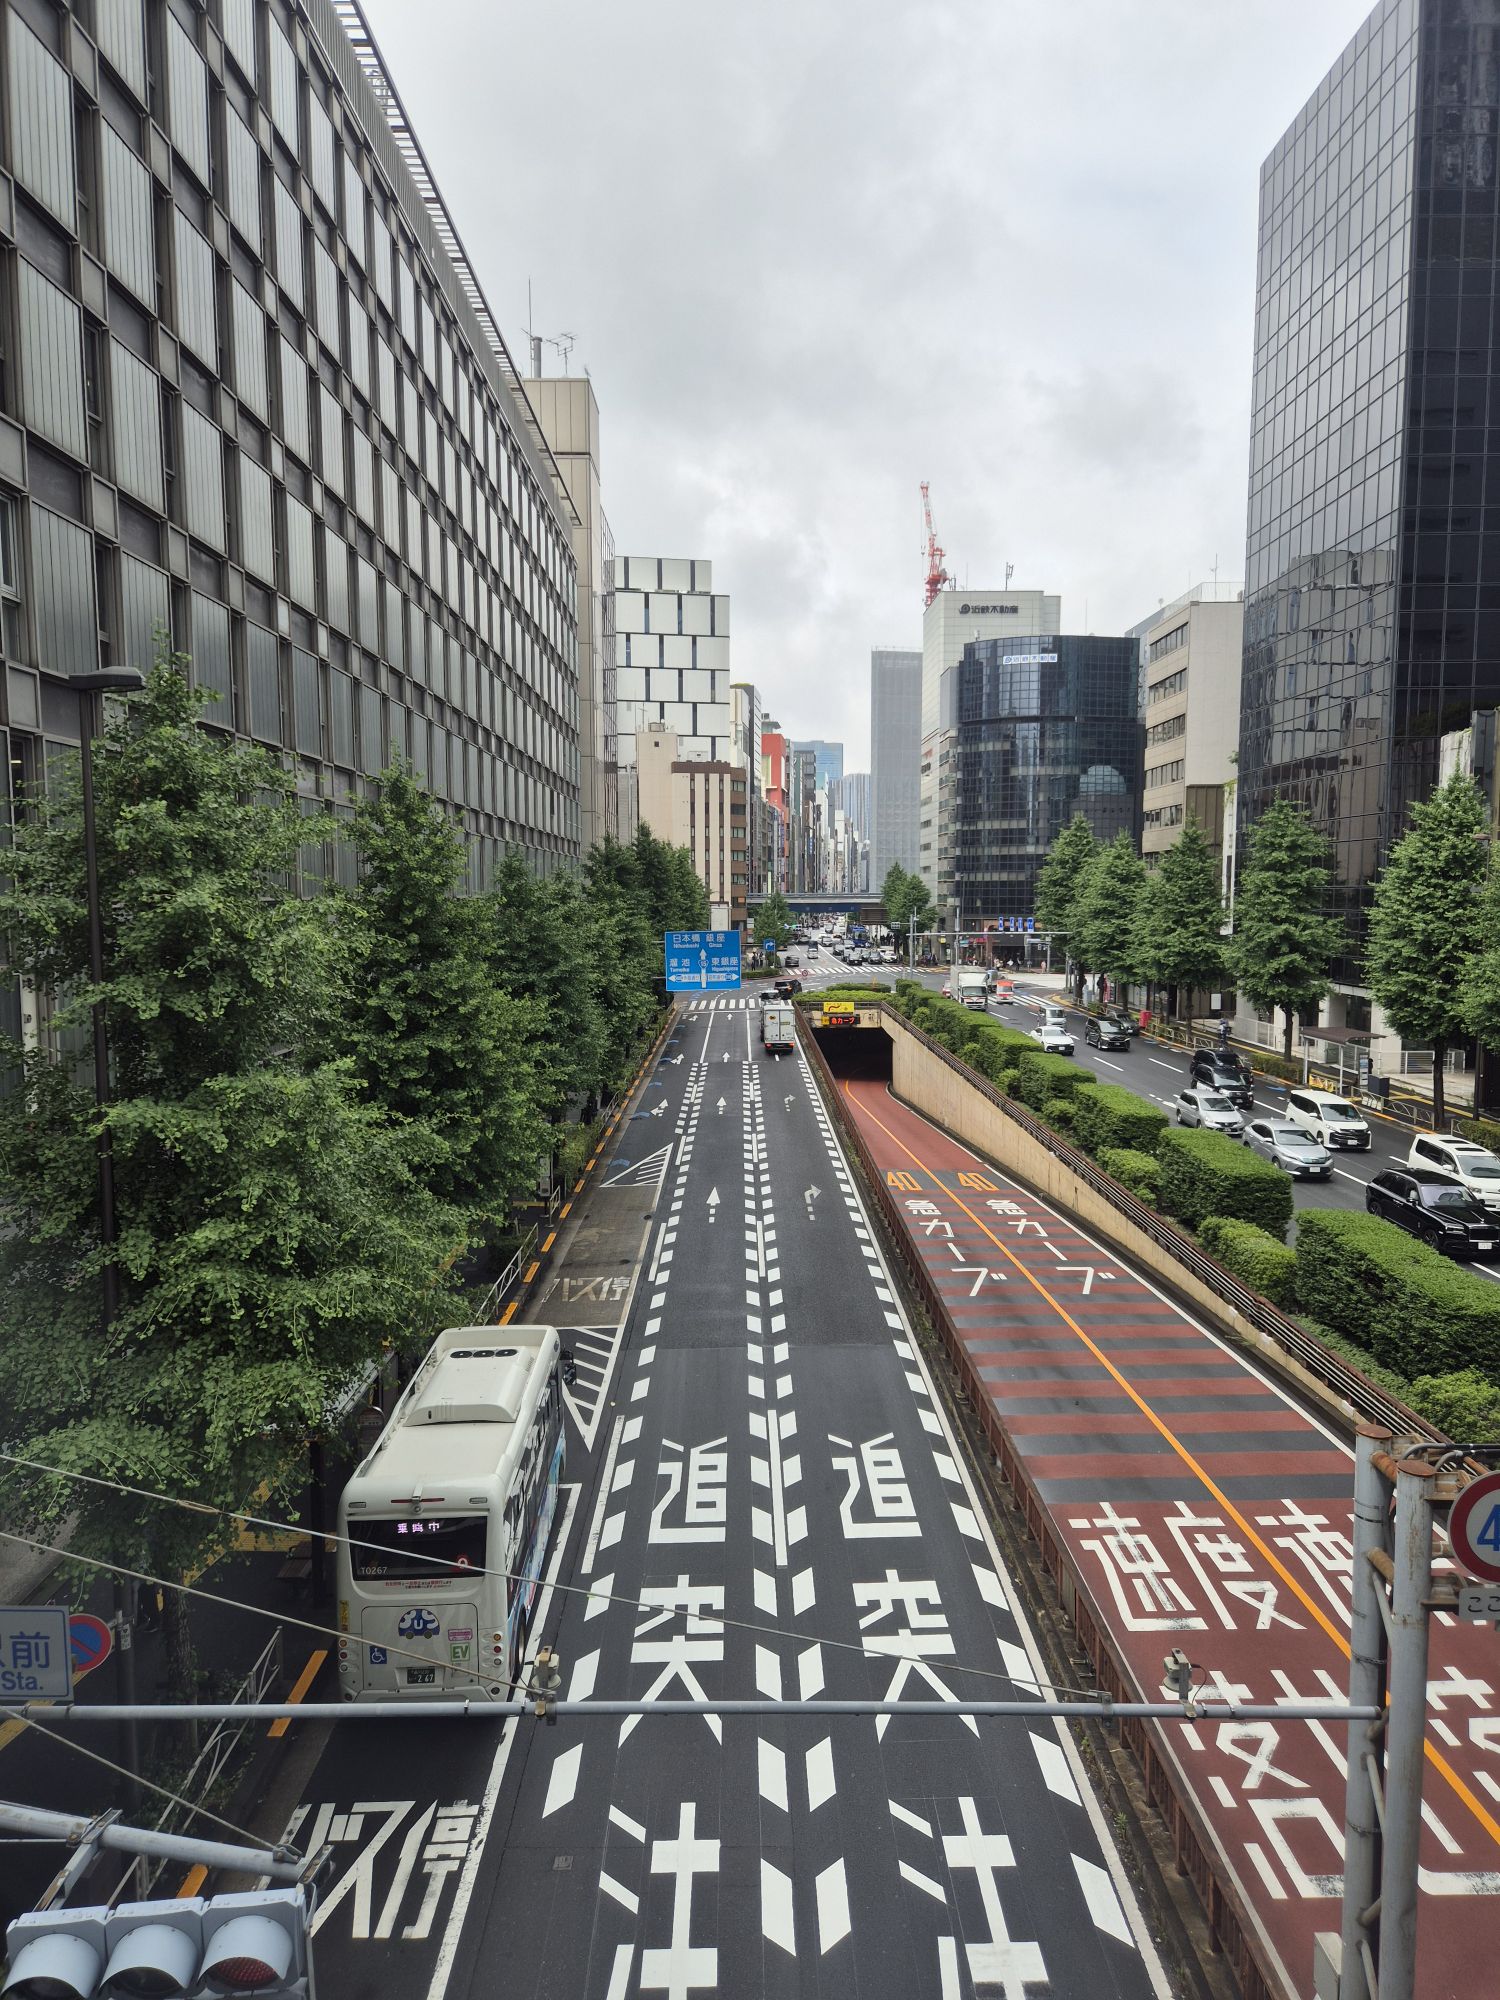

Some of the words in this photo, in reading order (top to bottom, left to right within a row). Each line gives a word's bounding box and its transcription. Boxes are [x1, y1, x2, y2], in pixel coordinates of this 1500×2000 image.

[672, 934, 701, 943] 日本橋
[705, 933, 725, 942] 銀座
[711, 957, 739, 966] 東銀座
[831, 1017, 856, 1025] 急カーブ
[887, 1171, 922, 1191] 40
[957, 1172, 999, 1191] 40
[541, 1276, 633, 1303] バス停
[0, 1631, 50, 1669] 前
[452, 1645, 469, 1659] EV
[1, 1671, 44, 1690] Sta.
